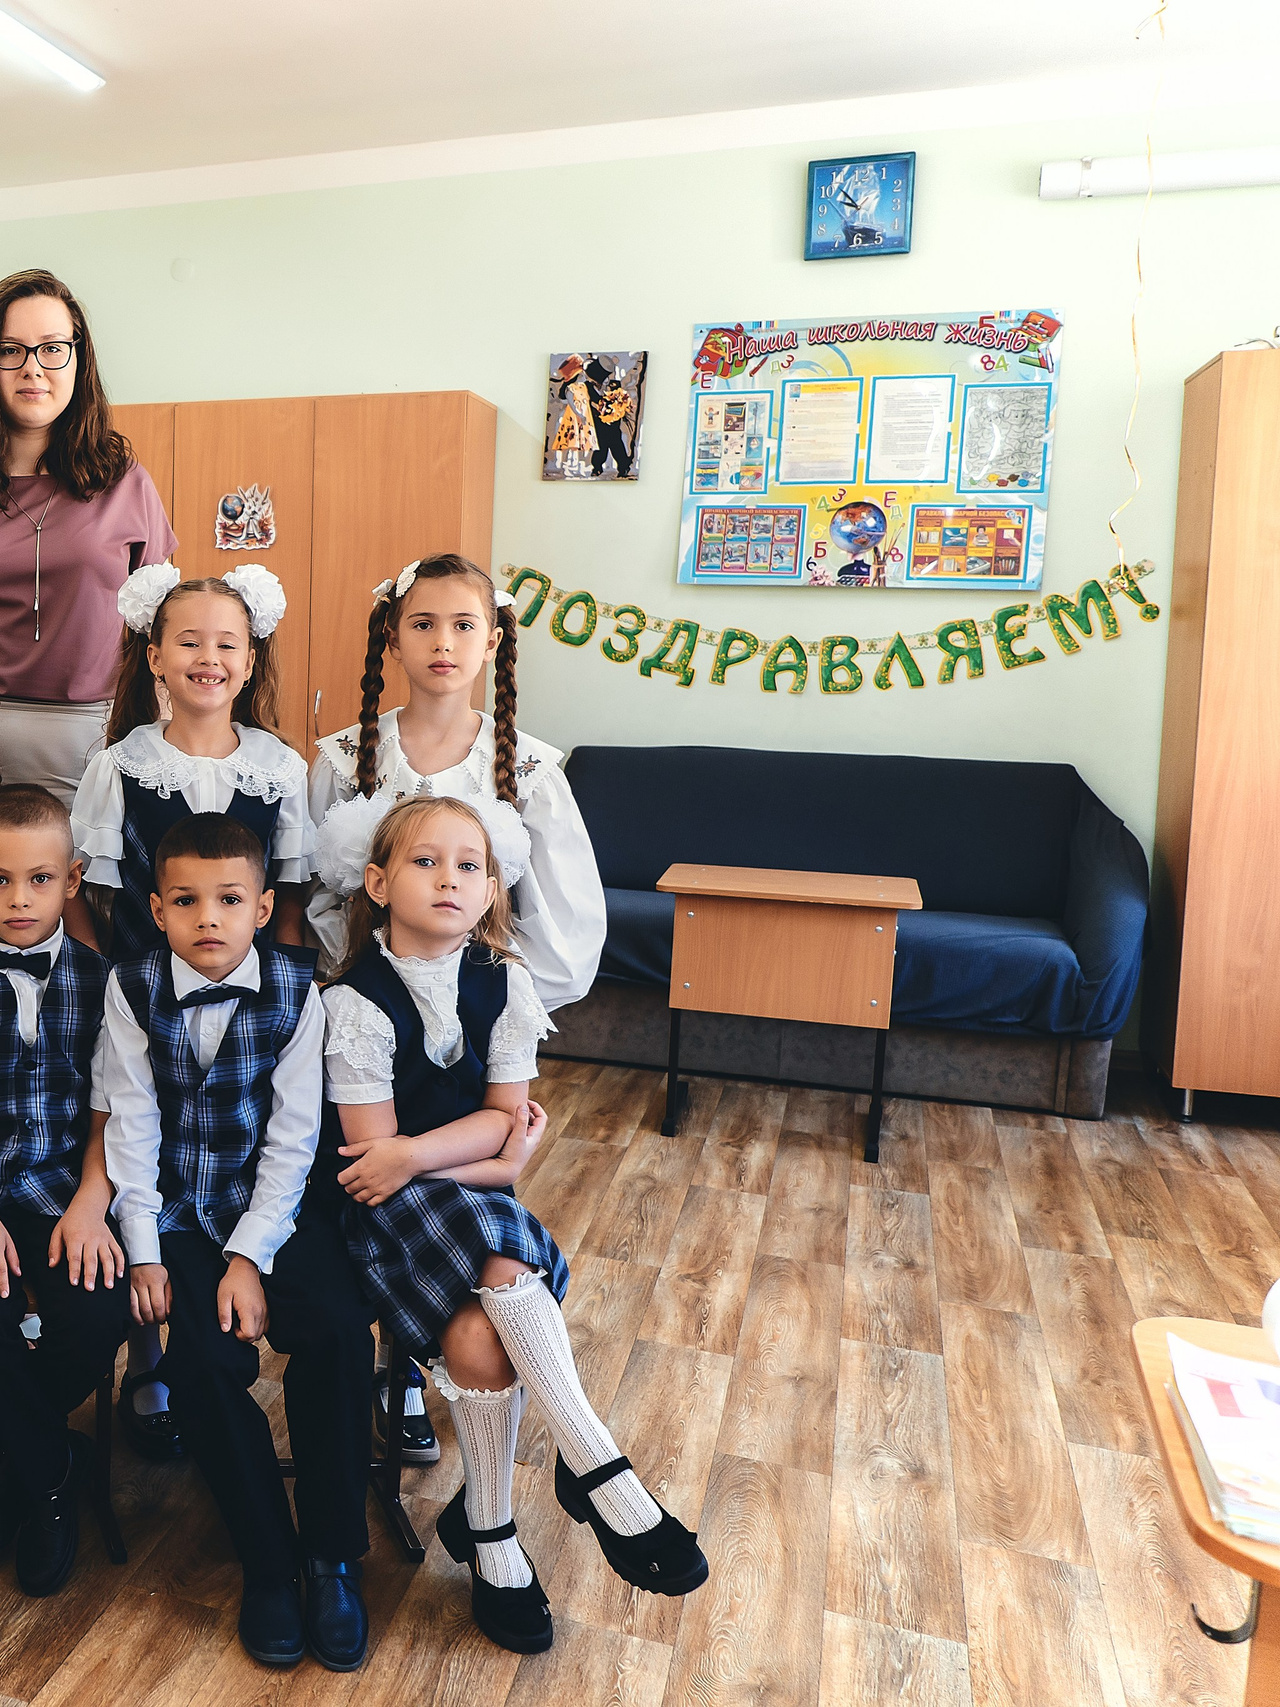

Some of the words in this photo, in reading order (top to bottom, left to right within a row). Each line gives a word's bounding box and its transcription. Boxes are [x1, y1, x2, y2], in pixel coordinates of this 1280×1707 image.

[831, 171, 845, 184] 11
[854, 168, 870, 182] 12
[881, 167, 887, 180] 1
[820, 185, 835, 199] 10
[893, 180, 902, 192] 2
[818, 204, 827, 217] 9
[892, 199, 901, 211] 3
[817, 223, 826, 236] 8
[891, 218, 899, 230] 4
[833, 235, 842, 248] 7
[853, 233, 862, 246] 6
[874, 232, 883, 245] 5
[726, 330, 797, 363] Наша
[807, 321, 936, 344] школьная
[944, 323, 1029, 352] жизнь
[506, 563, 1160, 694] ПОЗДРАВЛЯЕМ!
